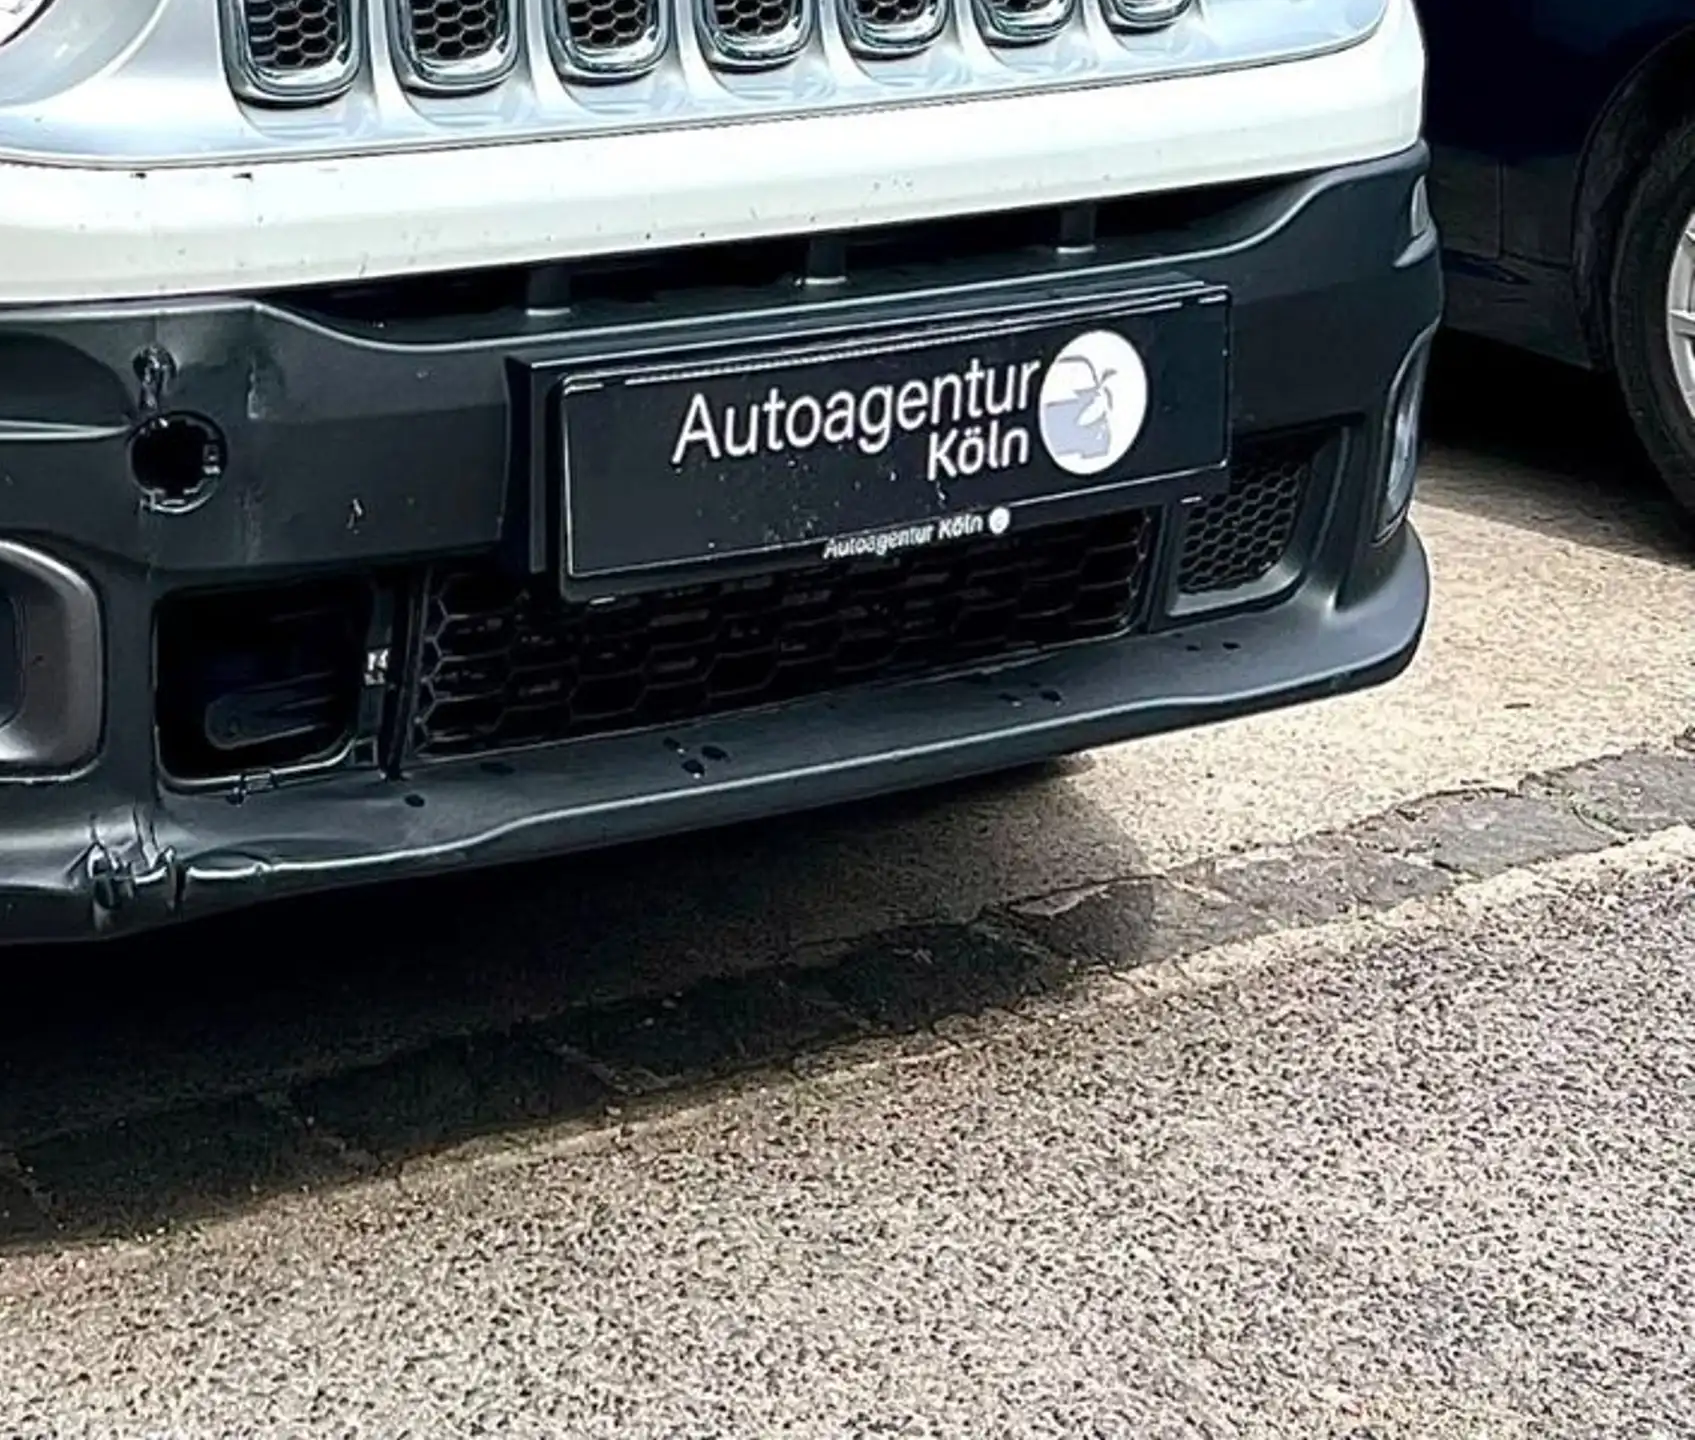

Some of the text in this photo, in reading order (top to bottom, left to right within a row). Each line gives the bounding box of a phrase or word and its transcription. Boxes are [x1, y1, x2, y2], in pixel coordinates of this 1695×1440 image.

[671, 357, 1042, 464] Autoagentur
[926, 419, 1030, 482] Köln
[822, 513, 985, 559] Autoagentur Köln
